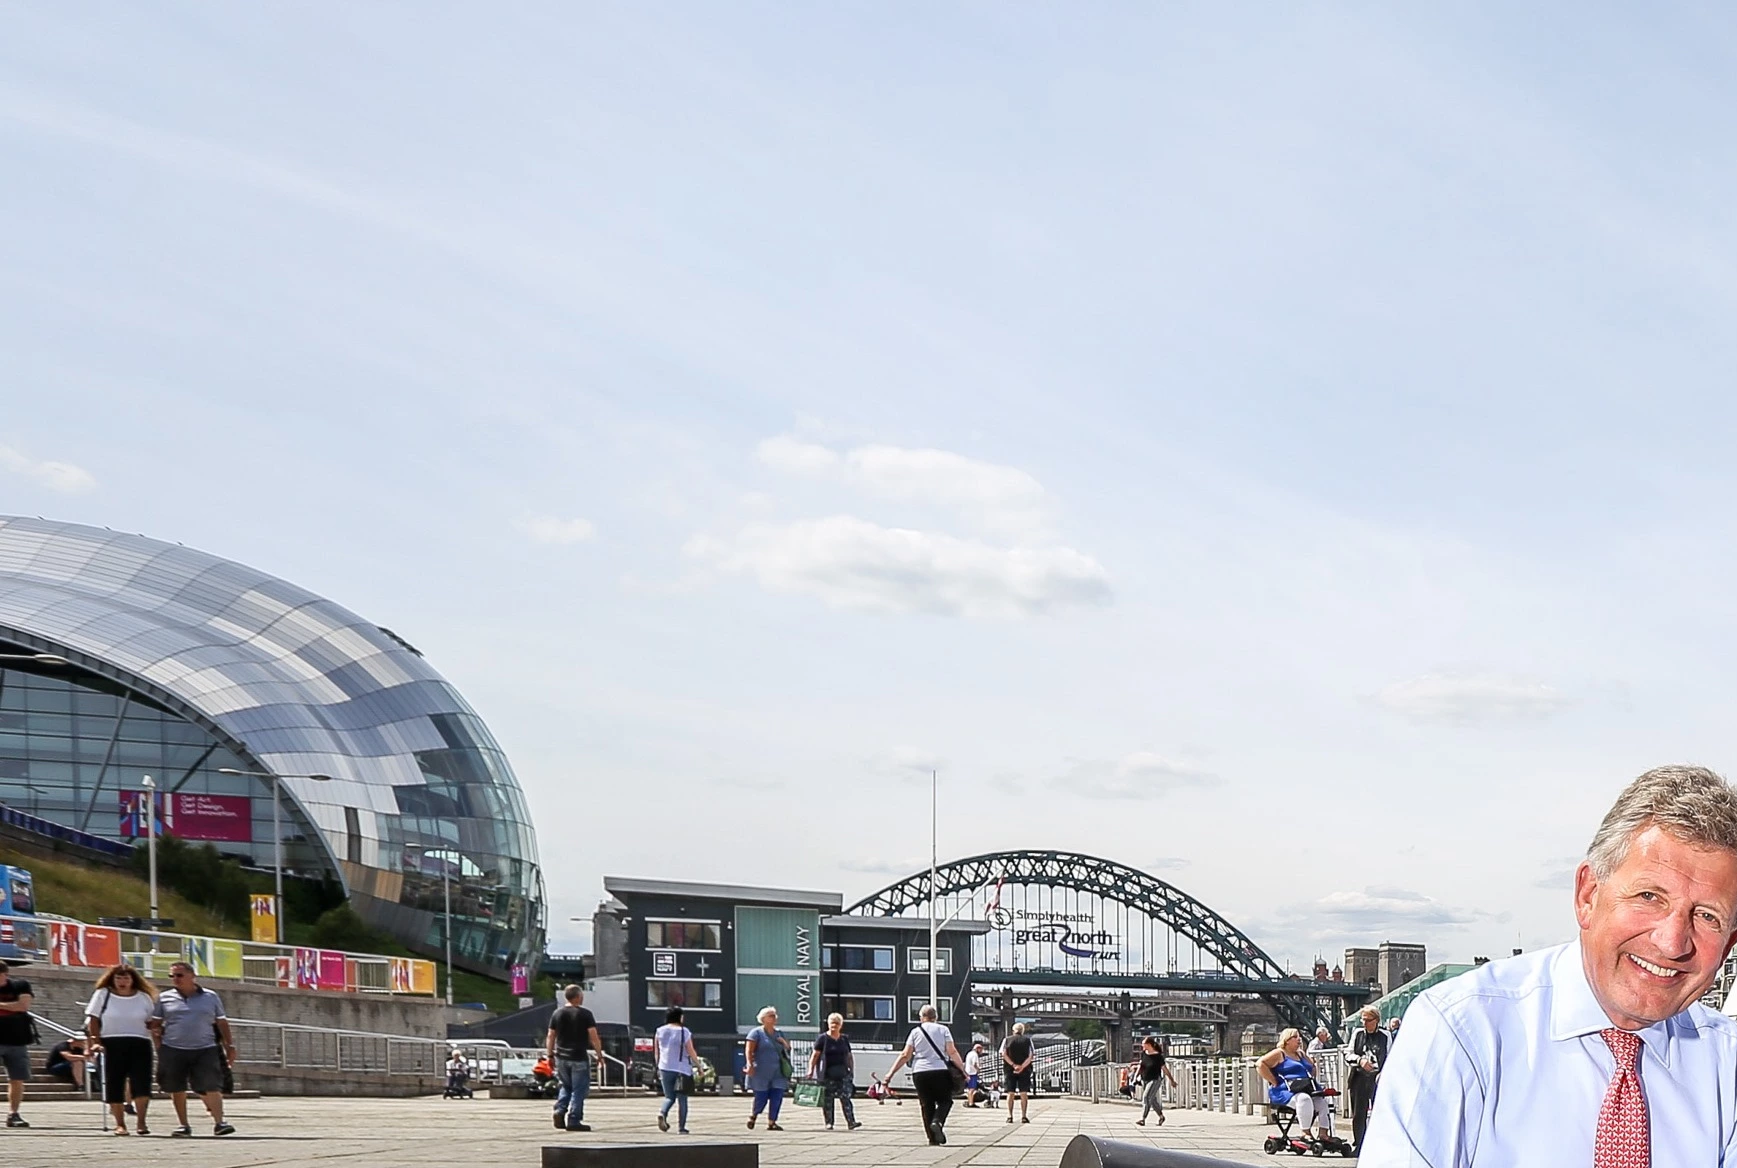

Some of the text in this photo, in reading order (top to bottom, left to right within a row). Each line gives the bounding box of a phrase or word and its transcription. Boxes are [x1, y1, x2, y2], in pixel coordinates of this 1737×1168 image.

[1016, 928, 1113, 945] great north
[796, 925, 811, 1023] ROYAL NAVY
